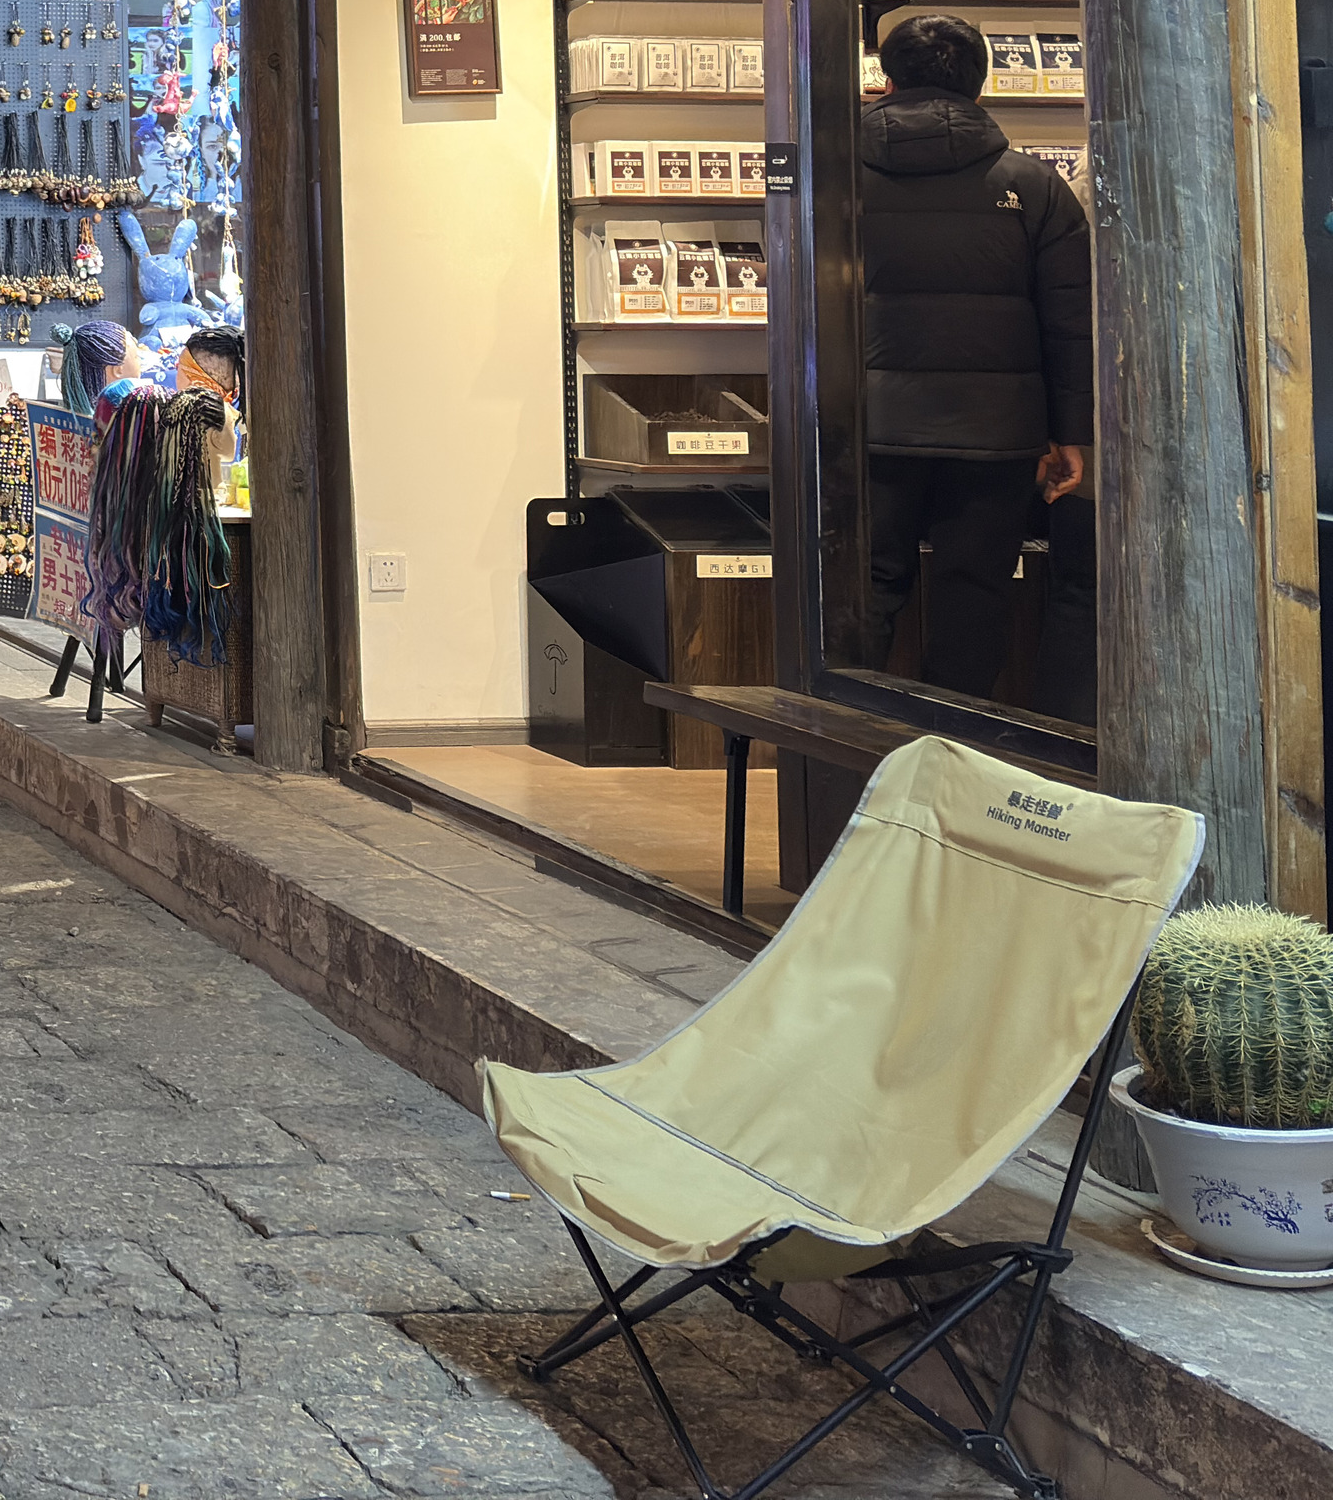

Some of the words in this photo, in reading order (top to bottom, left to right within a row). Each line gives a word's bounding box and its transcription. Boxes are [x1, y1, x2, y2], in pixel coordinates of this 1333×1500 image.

[996, 200, 1024, 210] CAMEL
[676, 440, 741, 450] 咖啡豆干果
[709, 563, 766, 574] 西达摩G1
[1007, 790, 1063, 820] 暴走怪兽
[987, 806, 1022, 830] Hiking
[1024, 818, 1071, 842] Monster
